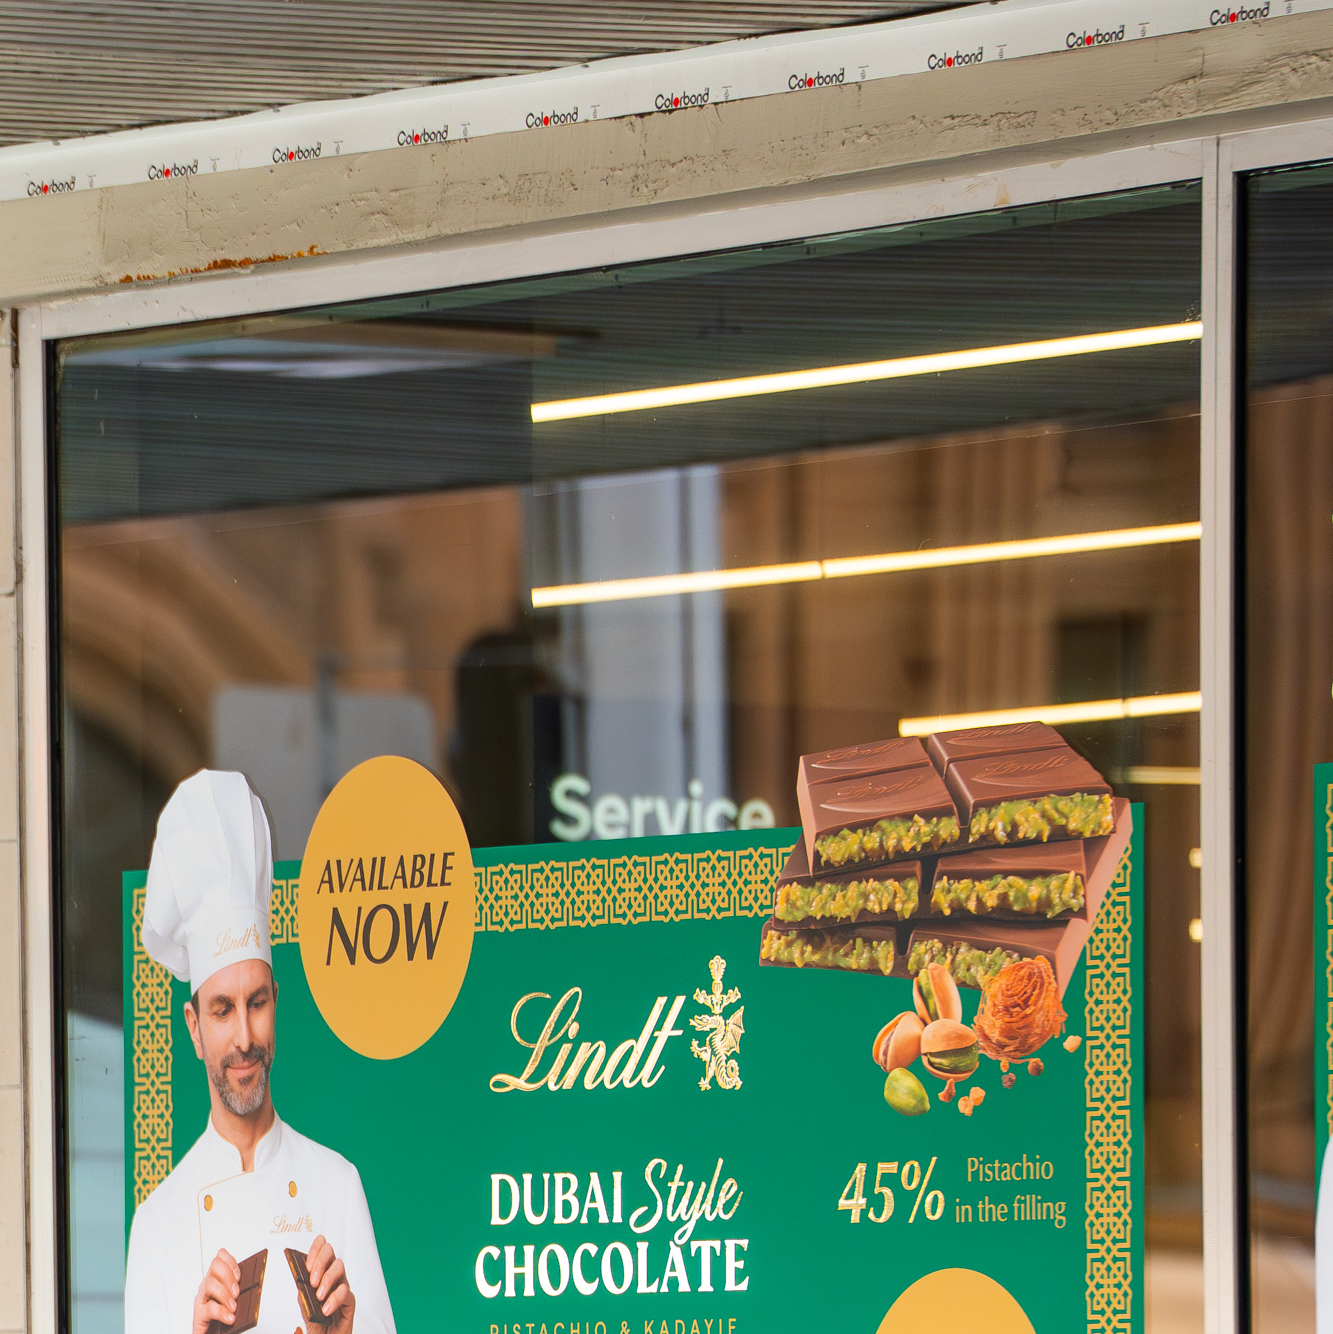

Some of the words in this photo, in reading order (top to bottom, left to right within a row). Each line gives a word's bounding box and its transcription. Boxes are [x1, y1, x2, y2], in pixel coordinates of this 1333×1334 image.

[1210, 2, 1271, 26] Colorbond
[1066, 24, 1123, 48] Colorbond
[928, 46, 983, 70] Colorbond
[788, 67, 843, 89] Colorbond
[656, 87, 709, 109] Colorbond
[526, 106, 578, 128] Colorbond
[396, 124, 447, 146] Colorbond
[272, 142, 321, 162] Colorbond
[148, 159, 197, 179] Colorbond
[27, 176, 77, 196] Colorbond
[549, 773, 775, 841] Service
[317, 852, 455, 895] AVAILABLE
[325, 901, 449, 966] NOW
[489, 987, 686, 1093] Lindt
[837, 1156, 945, 1224] 45%
[966, 1154, 1054, 1182] Pistachio
[490, 1171, 623, 1226] DUBAI
[628, 1157, 744, 1246] Style
[956, 1198, 974, 1224] in
[977, 1195, 1009, 1223] the
[1013, 1194, 1067, 1229] filling
[474, 1238, 750, 1299] CHOCOLATE
